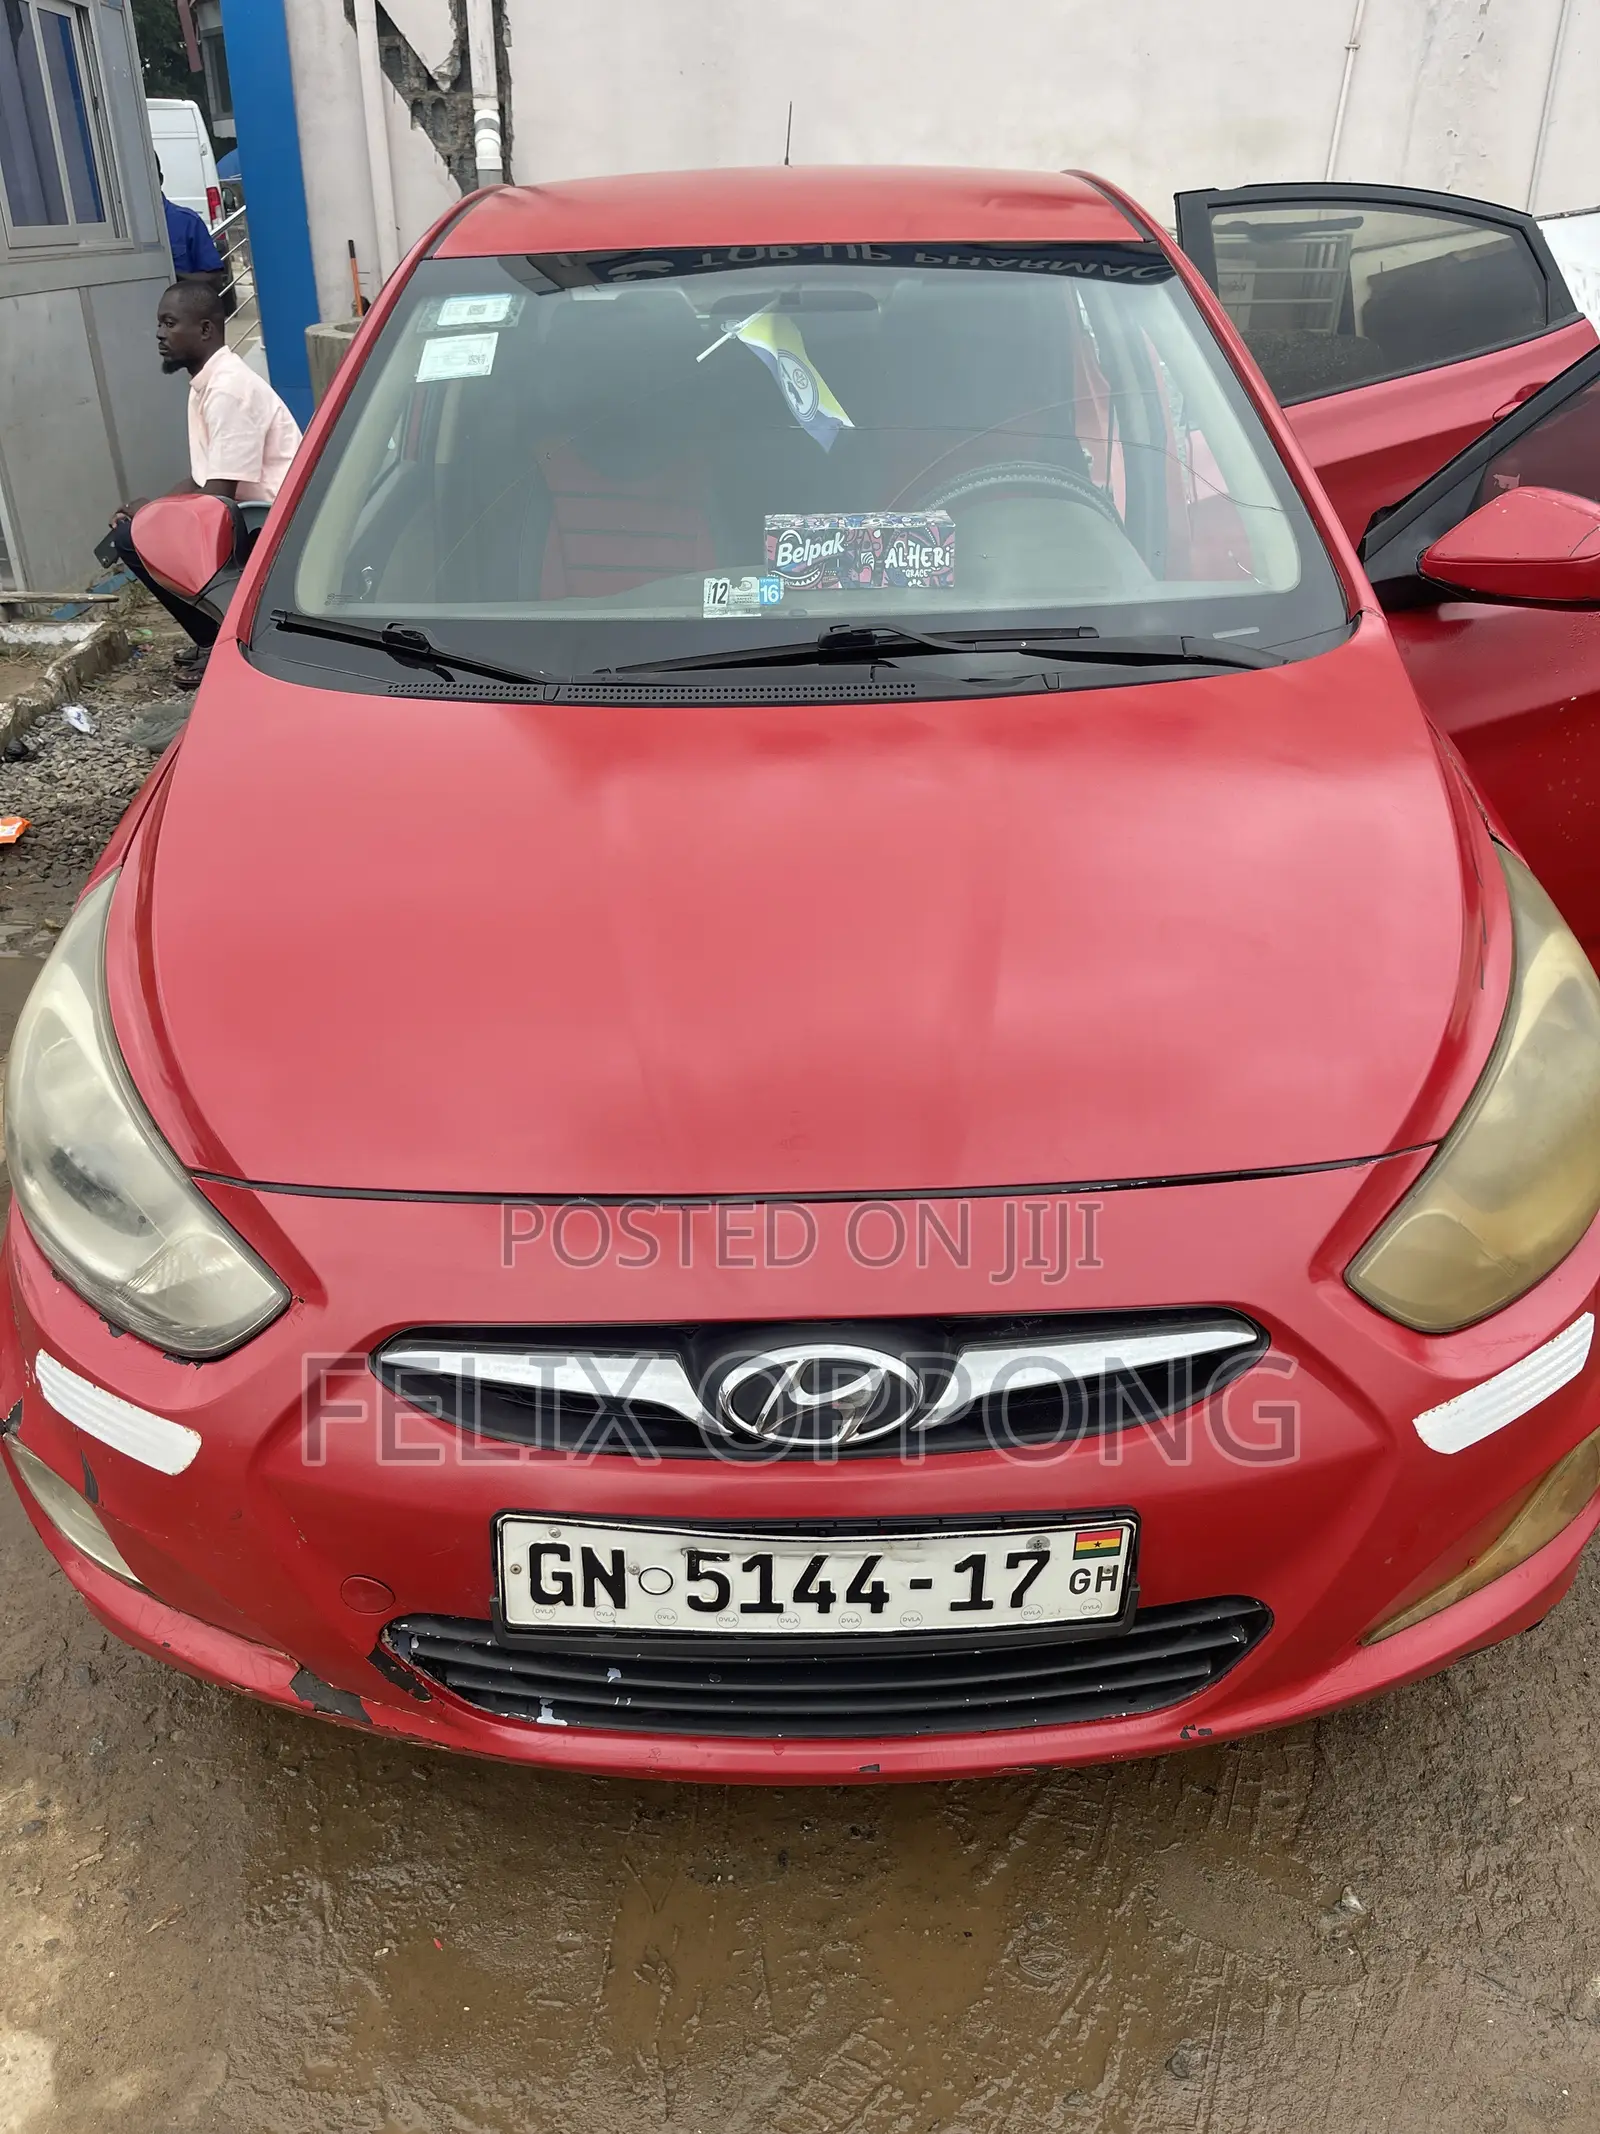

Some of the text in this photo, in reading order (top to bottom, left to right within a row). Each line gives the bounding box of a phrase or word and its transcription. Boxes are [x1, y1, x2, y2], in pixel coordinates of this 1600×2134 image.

[776, 532, 845, 567] Belpak
[711, 582, 728, 605] 12
[760, 584, 780, 603] 16
[528, 1542, 626, 1609] GN
[1069, 1564, 1120, 1595] GH
